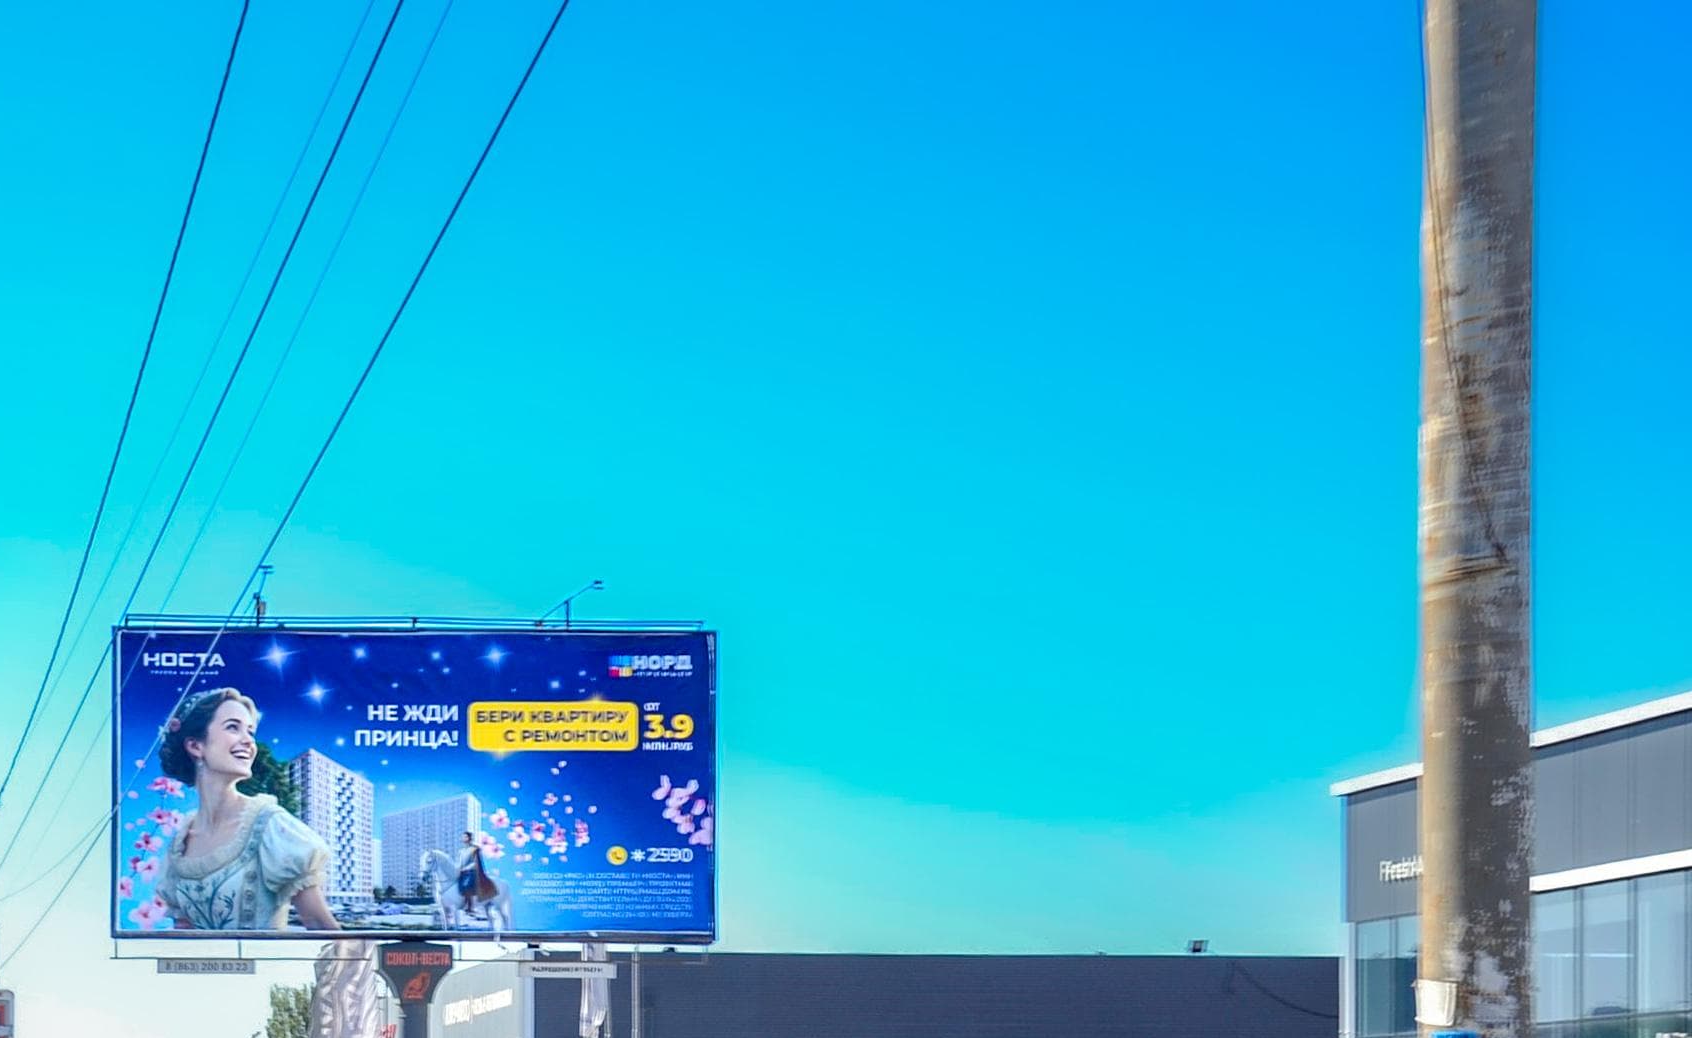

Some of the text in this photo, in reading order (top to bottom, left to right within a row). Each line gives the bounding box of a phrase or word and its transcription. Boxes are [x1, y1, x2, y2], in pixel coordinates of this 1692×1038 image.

[143, 652, 226, 667] НОСТА
[632, 655, 693, 670] НОРД
[367, 704, 459, 724] НЕ ЖДИ
[476, 710, 630, 723] БЕРИ КВАРТИРУ
[643, 713, 694, 739] 3.9
[354, 729, 459, 749] ПРИНЦА!
[504, 729, 629, 742] С РЕМОНТОМ
